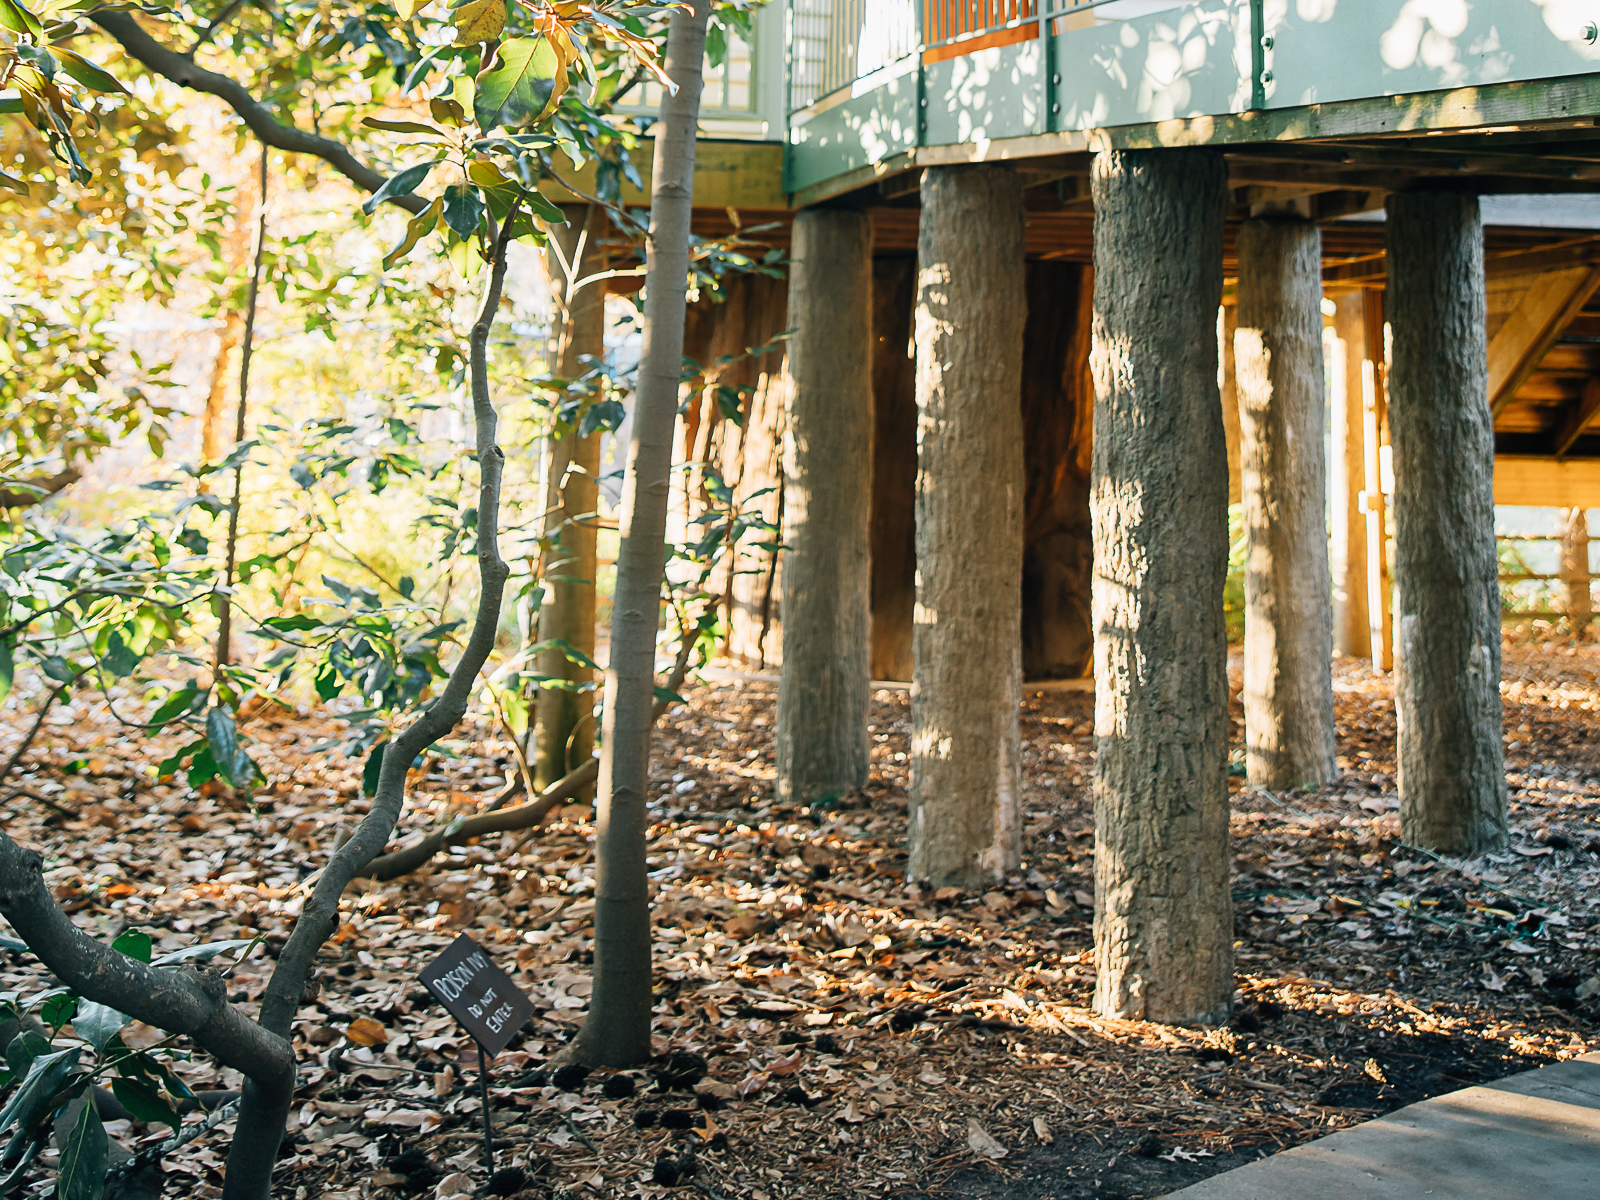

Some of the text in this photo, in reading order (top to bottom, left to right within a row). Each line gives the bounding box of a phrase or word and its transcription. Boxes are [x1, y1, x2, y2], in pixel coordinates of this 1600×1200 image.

[432, 951, 489, 1002] POISON IVY
[467, 987, 498, 1019] DO NOT
[485, 1001, 514, 1034] ENTER
